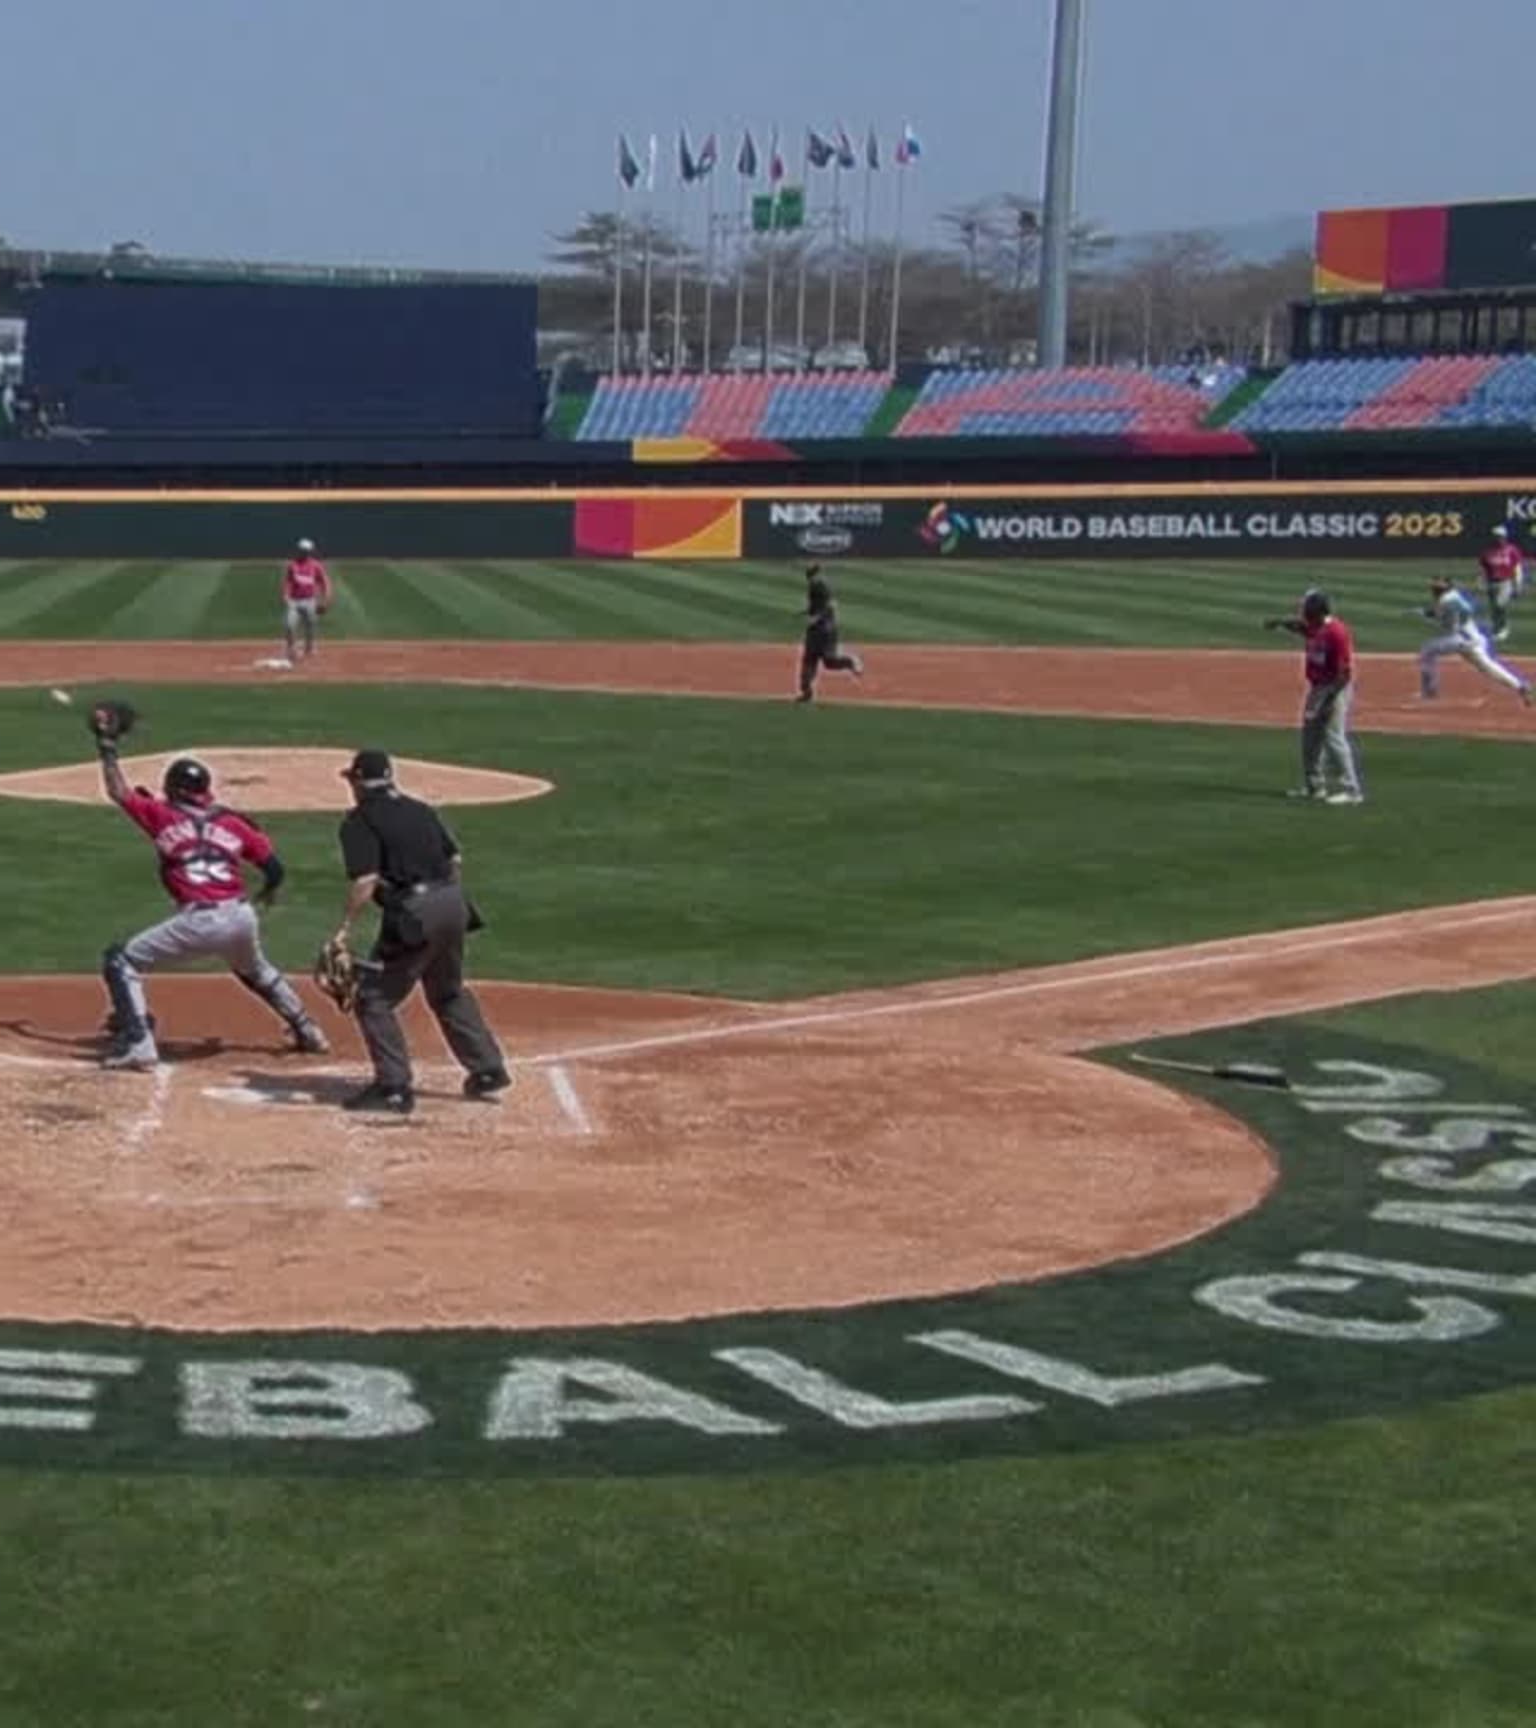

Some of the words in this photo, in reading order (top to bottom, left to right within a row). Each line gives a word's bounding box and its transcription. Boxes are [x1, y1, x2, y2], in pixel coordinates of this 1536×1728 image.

[975, 517, 1082, 539] WORLD
[1087, 514, 1241, 538] BASEBALL
[1246, 513, 1378, 537] CLASSIC
[1384, 513, 1463, 536] 2023
